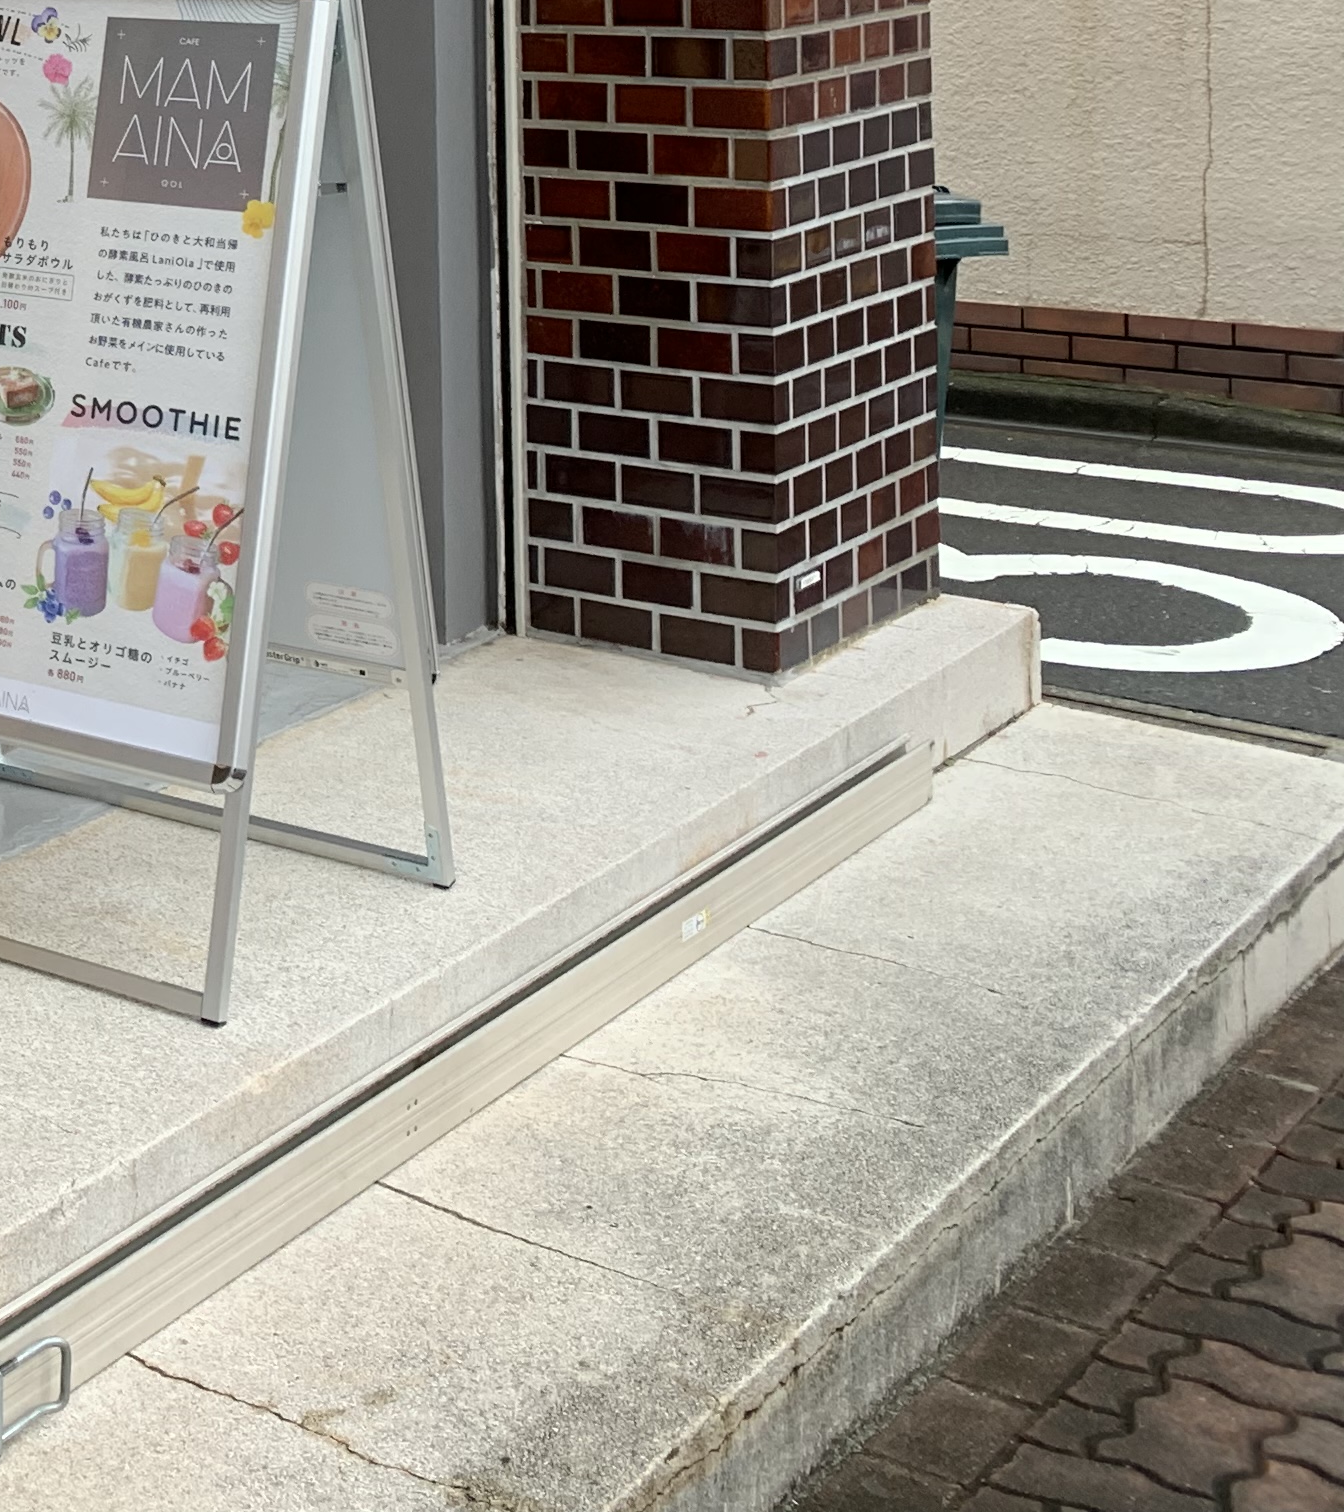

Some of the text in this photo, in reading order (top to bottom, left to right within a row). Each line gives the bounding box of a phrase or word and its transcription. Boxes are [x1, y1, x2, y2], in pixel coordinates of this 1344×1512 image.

[179, 38, 200, 46] CAFE
[120, 55, 252, 112] MAM
[112, 114, 242, 173] AINA
[161, 180, 183, 188] QOL
[4, 236, 49, 251] もりもり
[100, 226, 238, 250] 私たちは「ひのきと大和当帰
[97, 270, 233, 294] した、酵素たっぷりのひのきの
[93, 292, 231, 318] おがくずを肥料として、再利用
[90, 313, 228, 339] 頂いた有機農家さんの作った
[88, 335, 225, 362] お野菜をメインに使用している
[70, 393, 243, 442] SMOOTHIE
[49, 649, 111, 669] スムージー
[51, 631, 152, 664] 豆乳とオリゴ糖の
[266, 650, 300, 664] sterGrip
[167, 656, 189, 666] イチゴ
[166, 668, 210, 682] ブルーベリー
